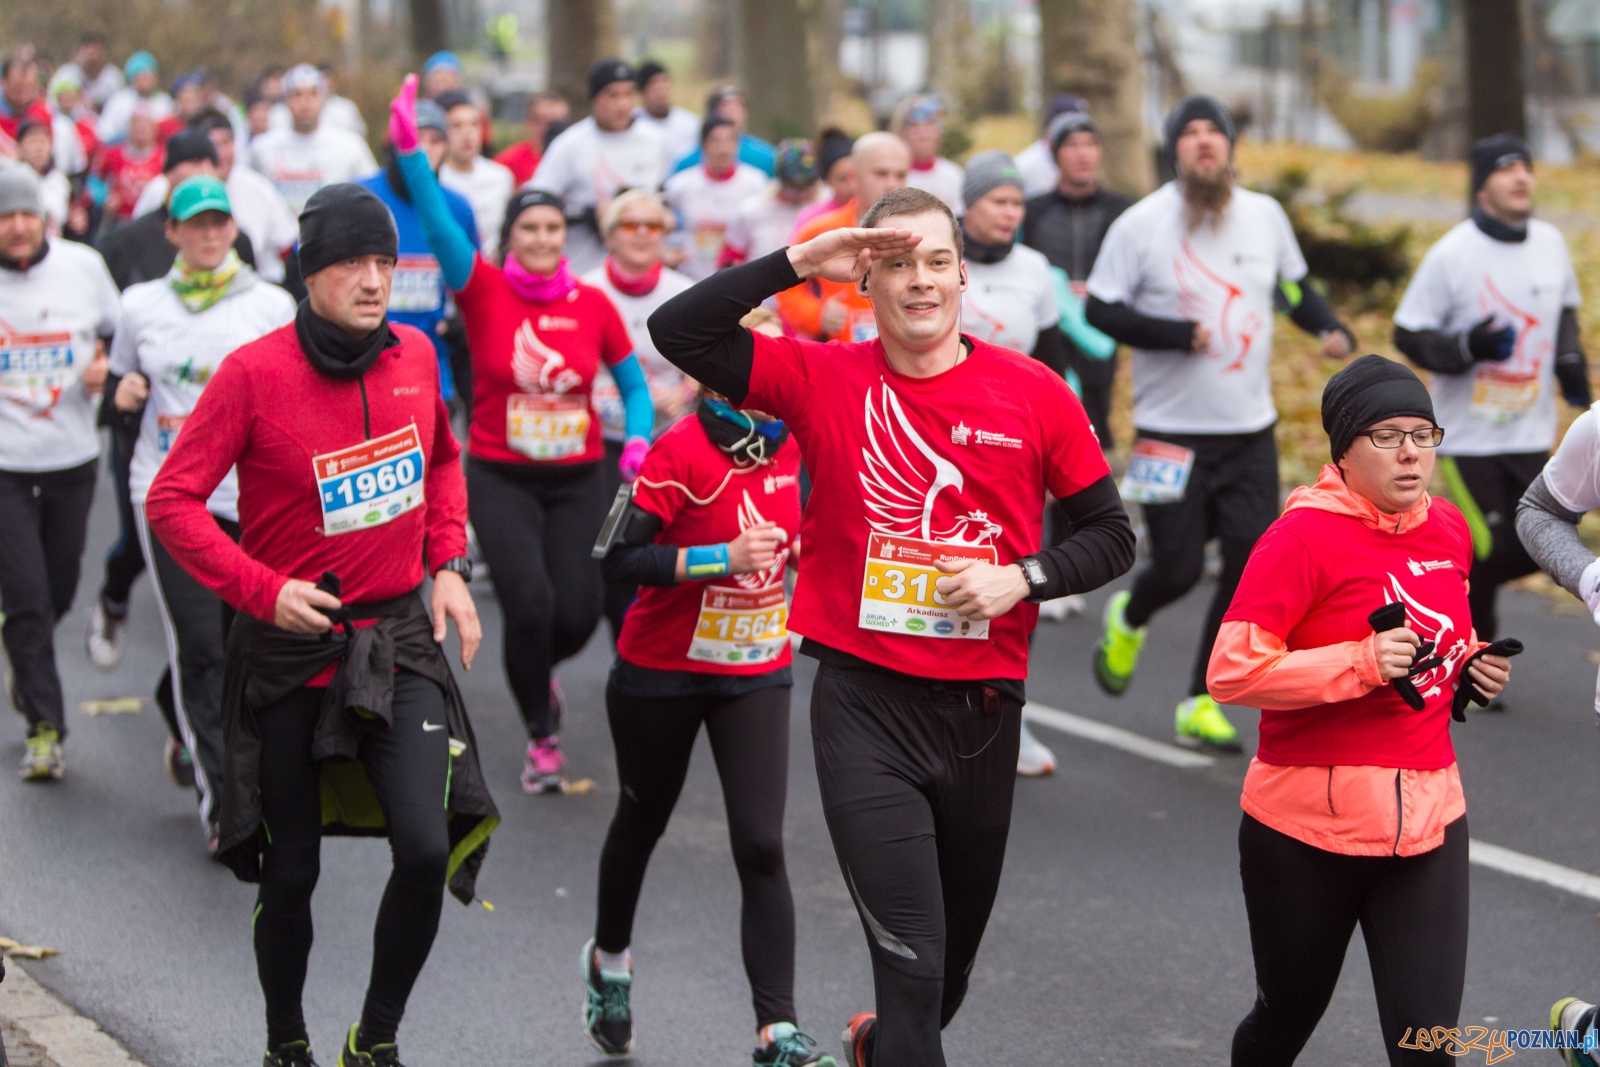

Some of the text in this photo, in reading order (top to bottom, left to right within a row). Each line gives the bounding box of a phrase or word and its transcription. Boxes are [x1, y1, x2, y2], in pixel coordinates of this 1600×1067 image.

[324, 491, 334, 503] E
[337, 457, 415, 505] 1960
[868, 575, 878, 586] D
[866, 613, 887, 621] GRUPA
[907, 607, 948, 617] Arkadiusz
[715, 610, 780, 639] 1564
[865, 619, 890, 627] LUXMED
